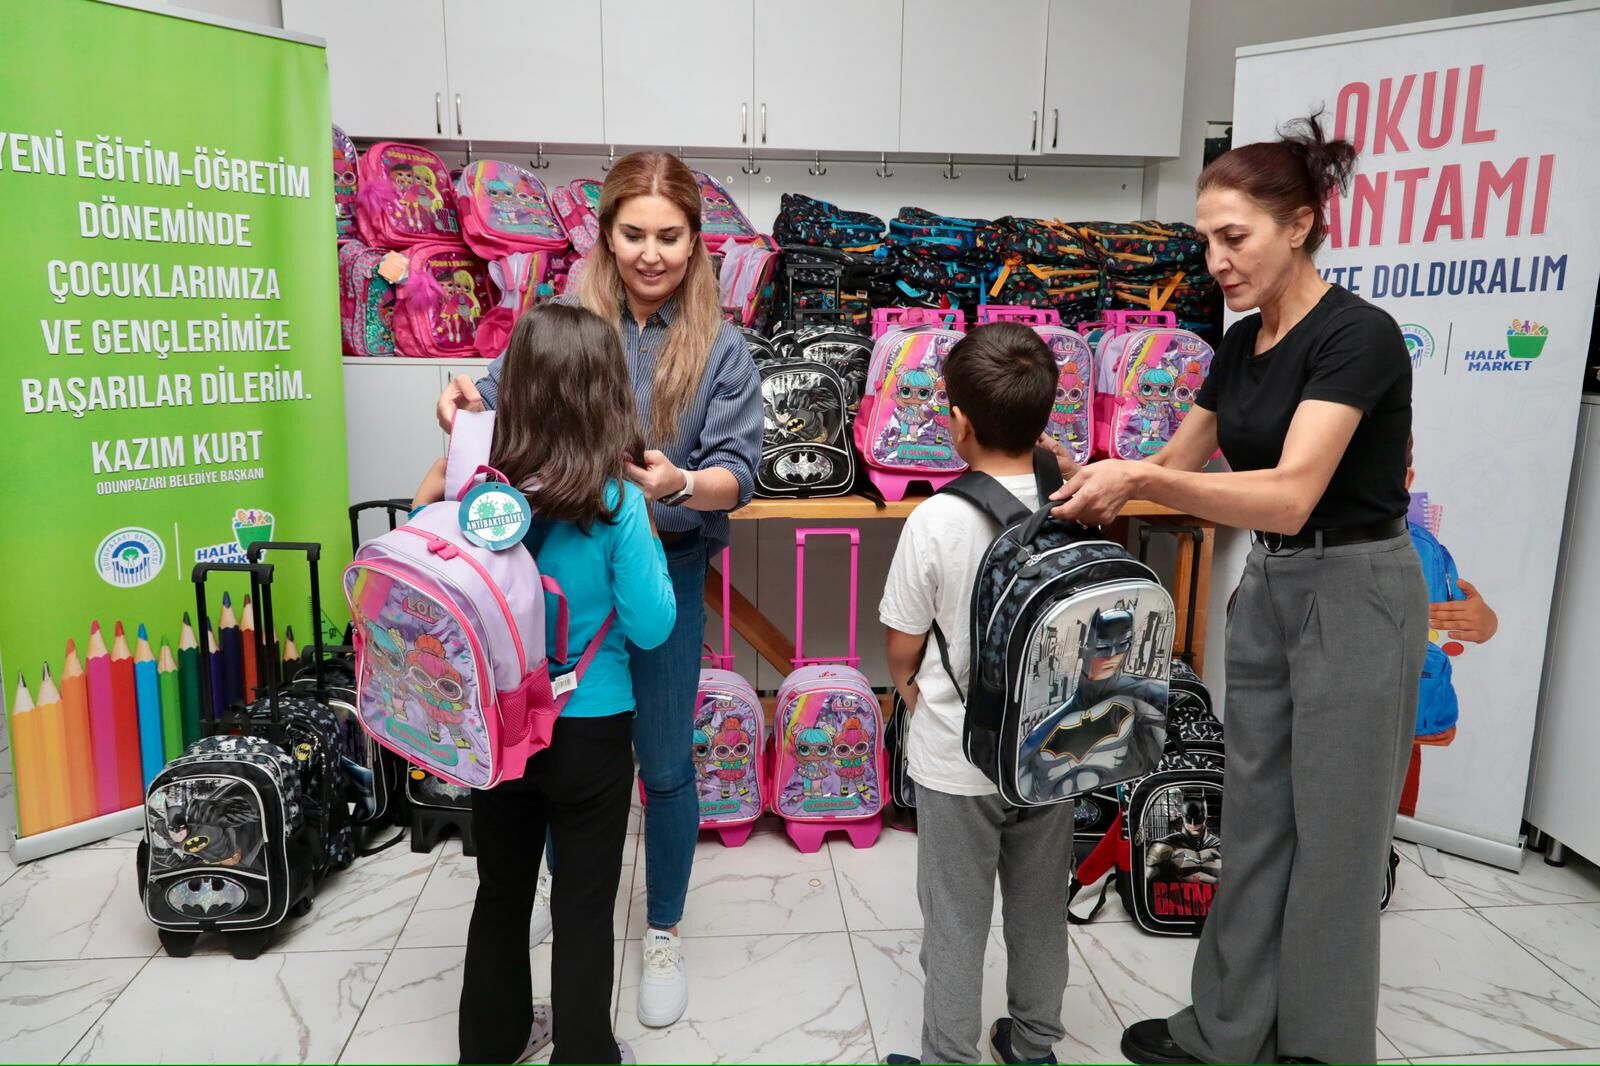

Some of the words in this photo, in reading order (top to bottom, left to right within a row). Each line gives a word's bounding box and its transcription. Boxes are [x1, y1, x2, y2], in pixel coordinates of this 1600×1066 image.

[1333, 64, 1497, 157] OKUL
[75, 133, 311, 198] EĞİTİM-ÖĞRETİM
[79, 195, 252, 247] DÖNEMİNDE
[47, 259, 281, 304] ÇOCUKLARIMIZA
[1371, 254, 1568, 299] DOLDURALIM
[40, 319, 84, 355] VE
[91, 312, 291, 360] GENÇLERİMİZE
[1464, 349, 1508, 361] HALK
[1468, 360, 1533, 372] MARKET
[21, 373, 193, 419] BAŞARILAR
[200, 363, 312, 405] DİLERİM.
[91, 435, 185, 474] KAZIM
[193, 430, 264, 466] KURT
[96, 477, 167, 496] ODUNPAZARI
[169, 469, 218, 489] BELEDİYE
[220, 466, 265, 484] BAŞKANI
[197, 543, 239, 561] HALK
[1153, 882, 1217, 915] BATM
